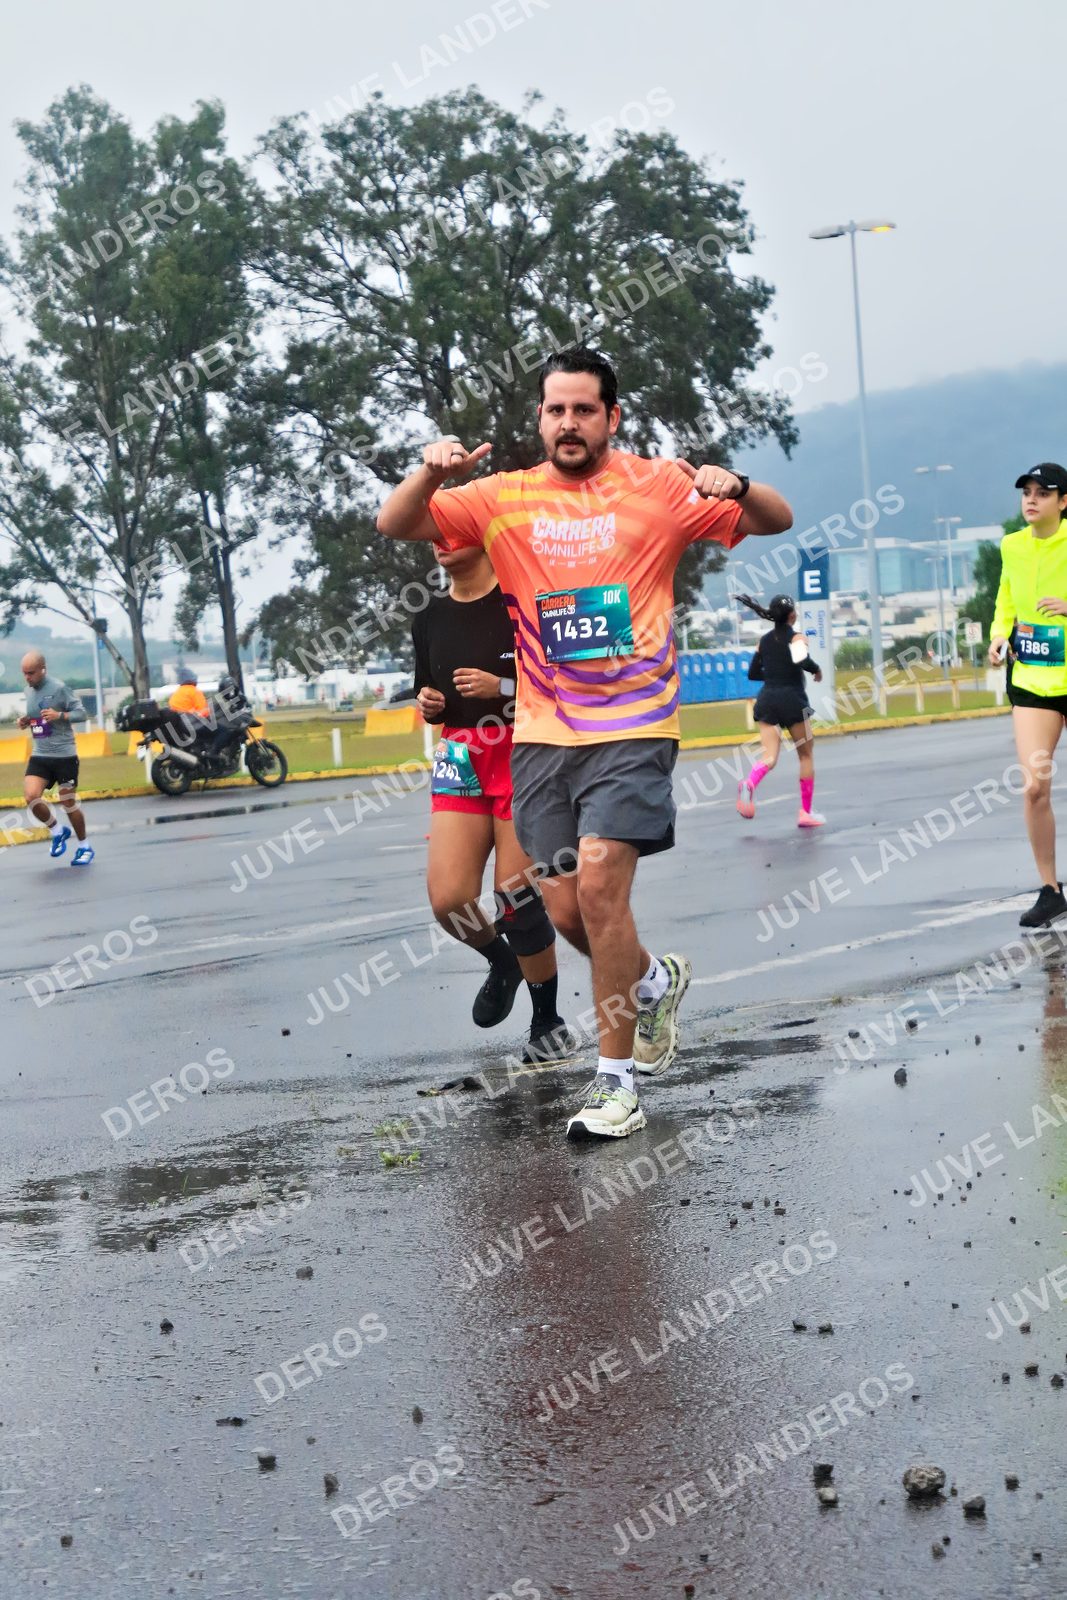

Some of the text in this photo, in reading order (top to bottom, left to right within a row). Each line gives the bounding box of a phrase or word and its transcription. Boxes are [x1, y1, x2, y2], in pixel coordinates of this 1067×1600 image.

[533, 512, 616, 541] CARRERA
[532, 540, 597, 558] OMNILIFE
[804, 569, 822, 595] E
[541, 595, 576, 611] CARRERA
[603, 590, 621, 604] 10K
[552, 616, 609, 642] 1432
[1020, 639, 1050, 656] 1386
